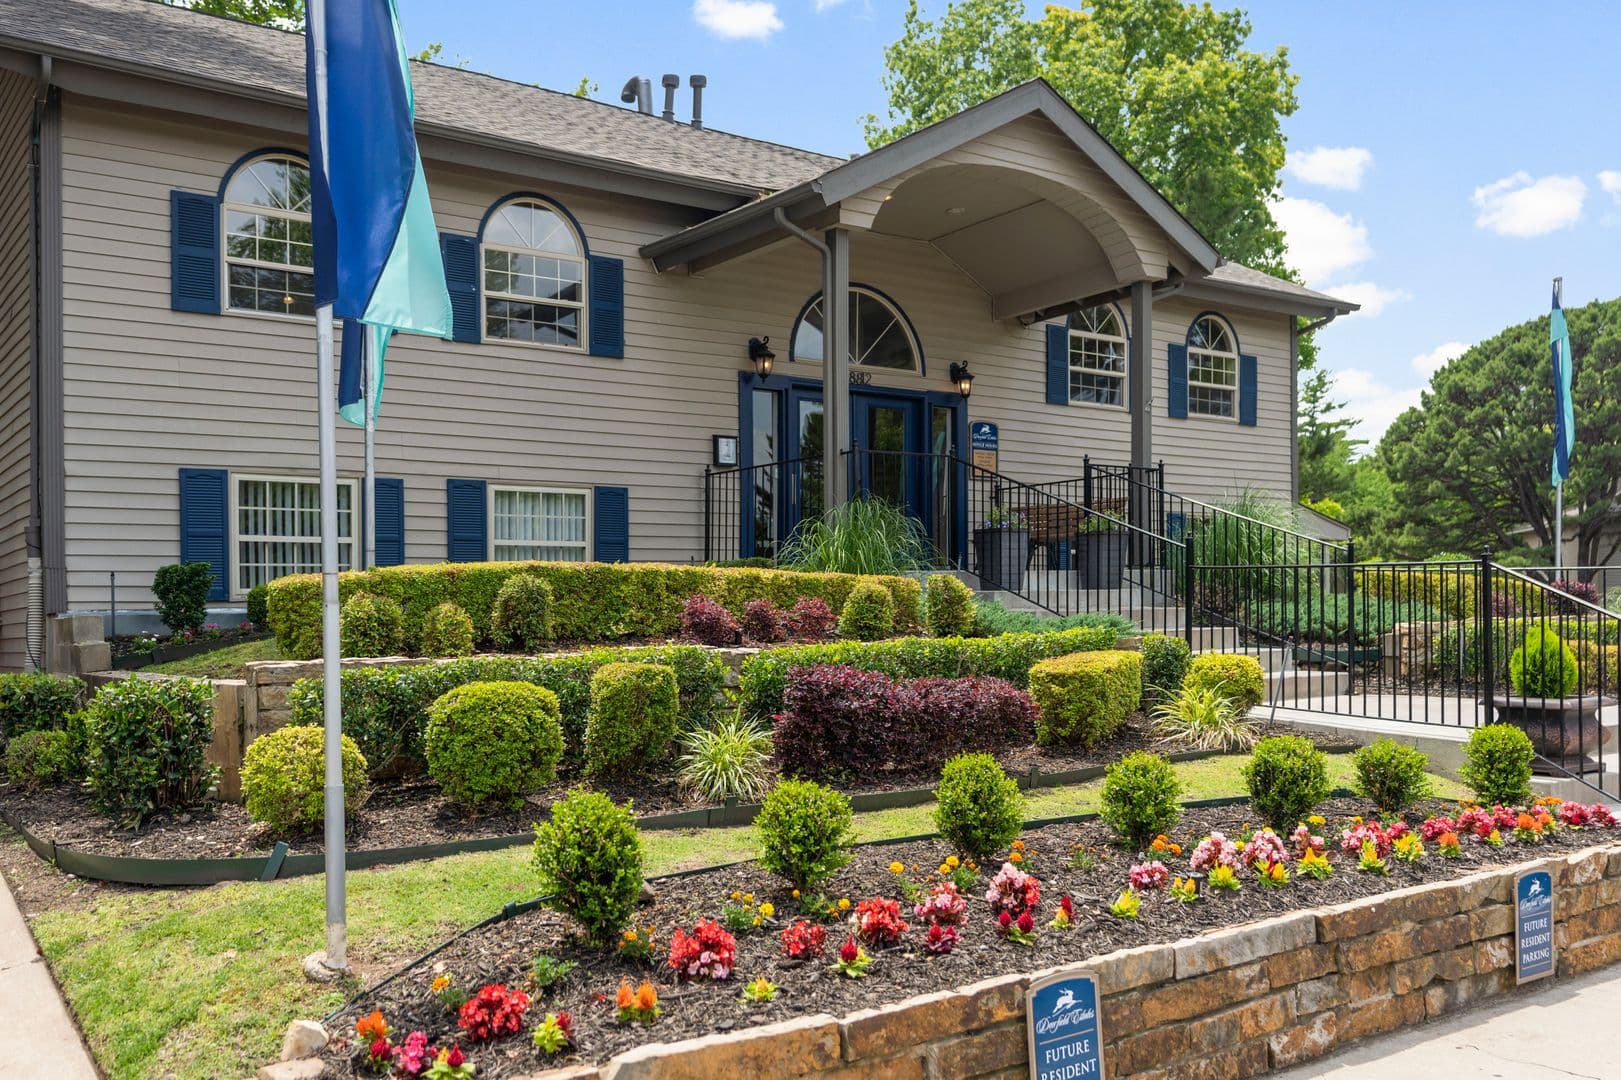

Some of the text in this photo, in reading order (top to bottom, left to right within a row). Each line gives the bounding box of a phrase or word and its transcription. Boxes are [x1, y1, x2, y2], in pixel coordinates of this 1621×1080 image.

[1523, 918, 1548, 933] FUTURE
[1521, 932, 1551, 949] RESIDENT
[1522, 948, 1550, 964] PARKING
[1045, 1039, 1090, 1064] FUTURE
[1041, 1058, 1097, 1080] RESIDENT
